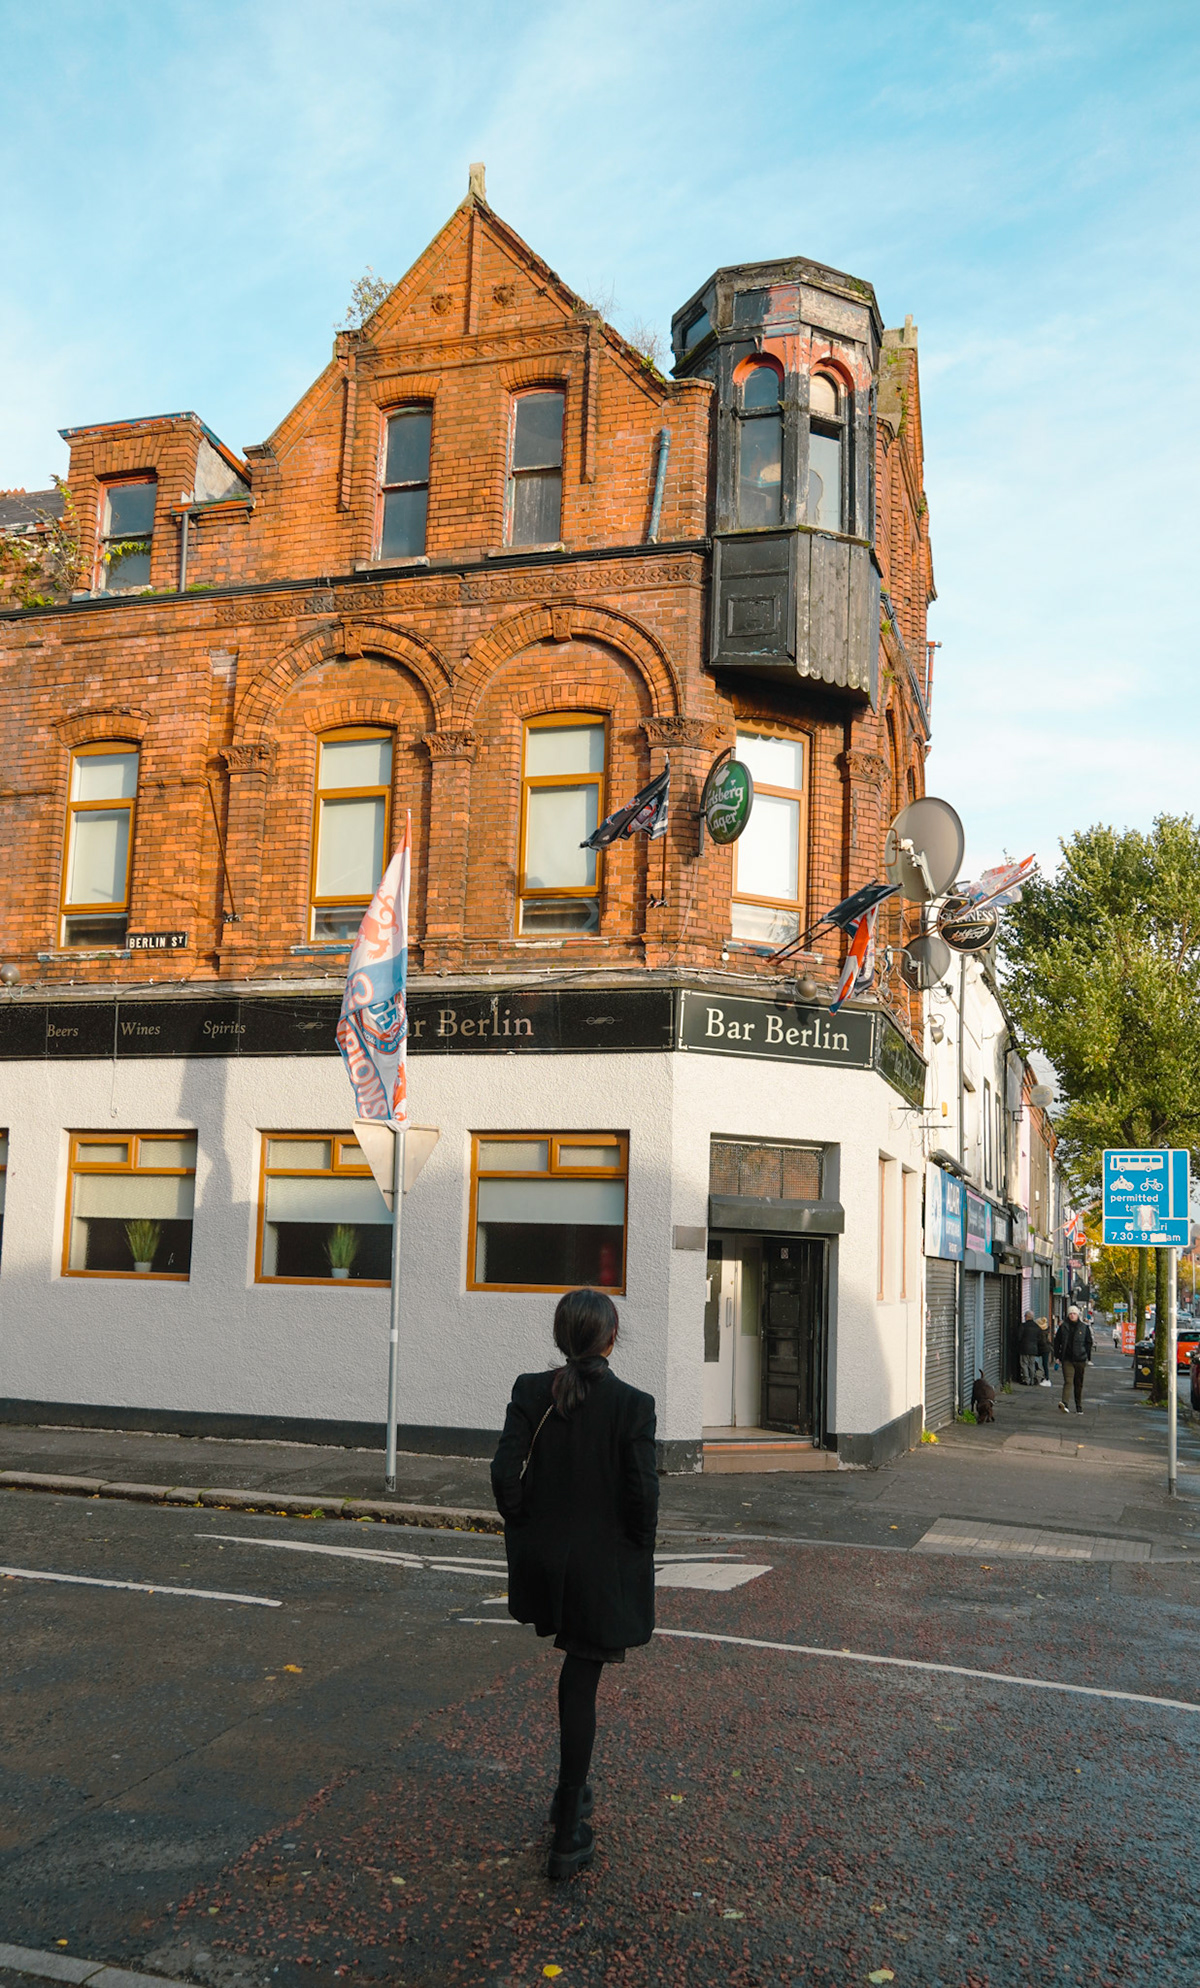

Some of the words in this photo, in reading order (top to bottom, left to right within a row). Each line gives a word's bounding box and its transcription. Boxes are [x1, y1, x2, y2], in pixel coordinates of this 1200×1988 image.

[129, 937, 166, 948] BERLIN
[171, 936, 184, 947] ST
[121, 1021, 161, 1036] Wines
[437, 1006, 534, 1037] Berlin
[47, 1023, 79, 1037] Beers
[203, 1020, 246, 1038] Spirits
[705, 1007, 755, 1041] Bar
[764, 1014, 850, 1051] Berlin
[1110, 1194, 1159, 1204] permitted
[1111, 1231, 1134, 1241] 7.30
